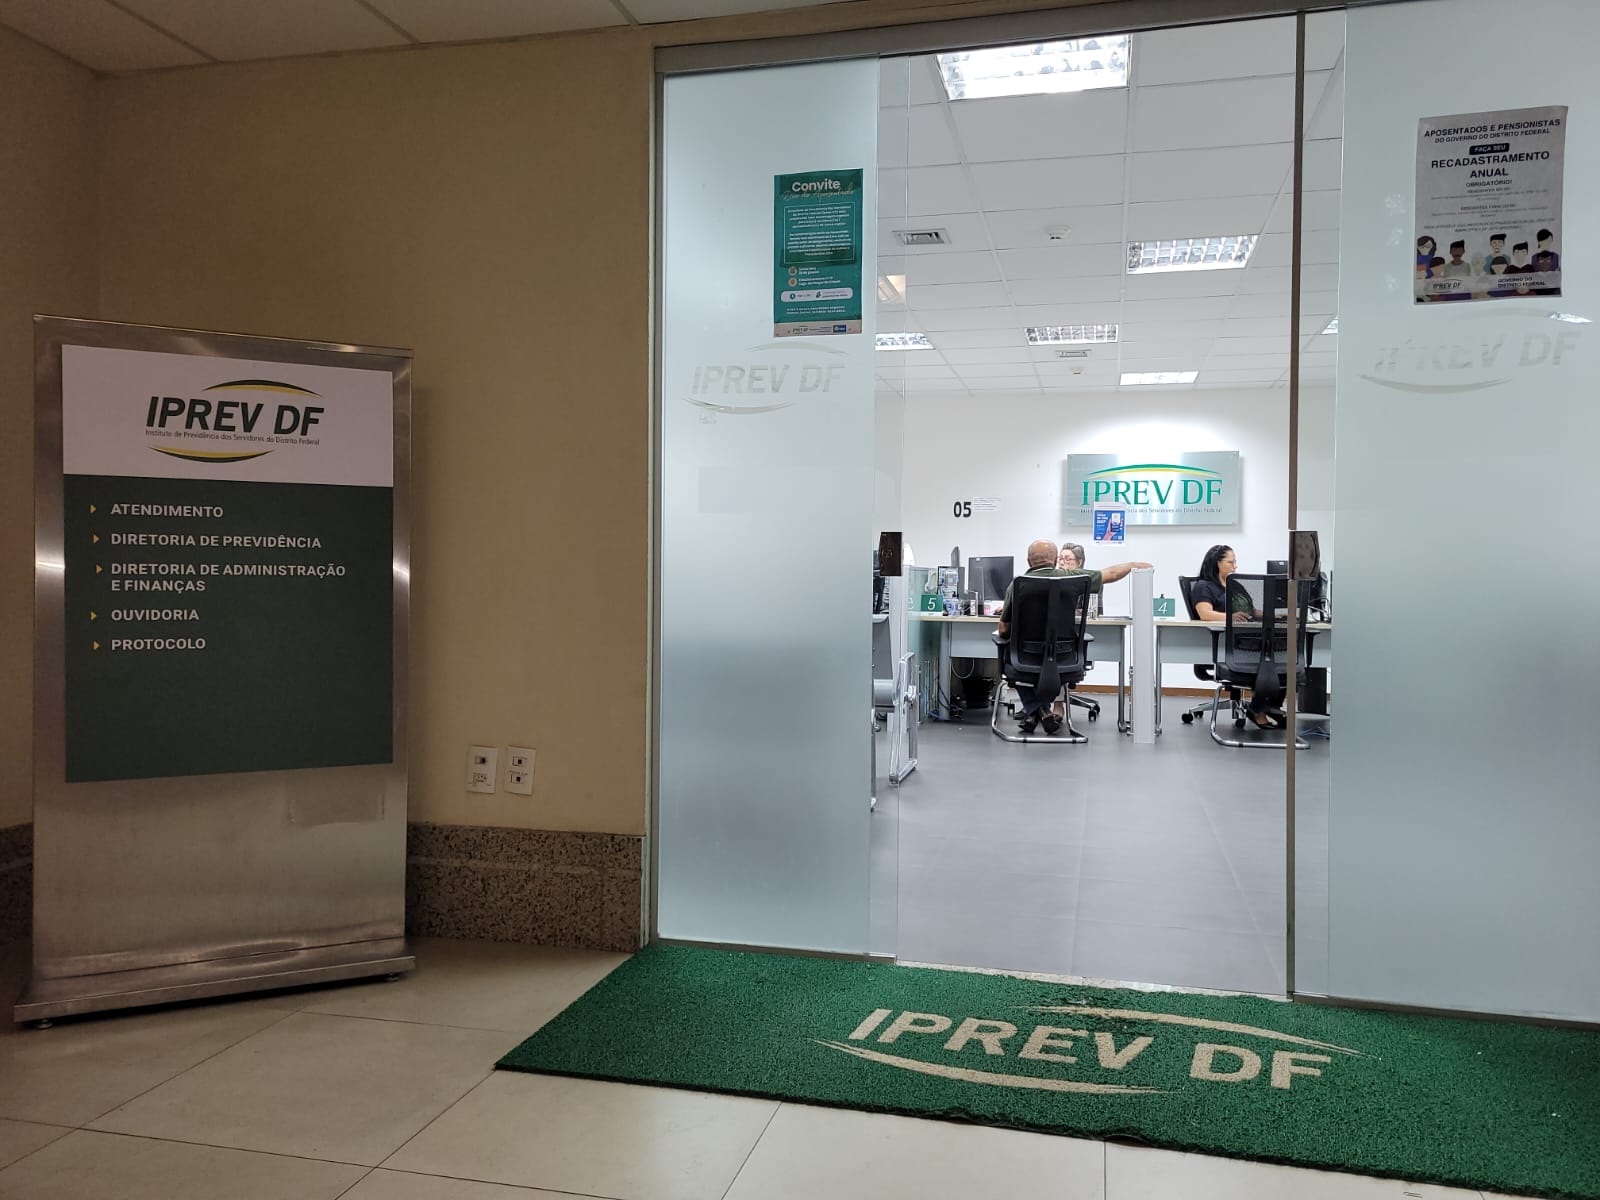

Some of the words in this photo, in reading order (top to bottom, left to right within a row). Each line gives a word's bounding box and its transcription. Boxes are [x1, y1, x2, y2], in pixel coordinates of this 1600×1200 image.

[1424, 125, 1488, 137] APOSENTADOS
[1498, 119, 1561, 130] PENSIONISTAS
[1446, 134, 1478, 142] GOVERNO
[1490, 130, 1519, 138] DISTRITO
[1521, 128, 1550, 136] FEDERAL
[1431, 151, 1550, 168] RECADASTRAMENTO
[1470, 167, 1509, 178] ANUAL
[791, 178, 841, 192] Convite
[691, 363, 790, 394] IPREV
[798, 362, 846, 393] DF
[146, 396, 264, 433] IPREV
[273, 404, 325, 436] DF
[183, 432, 219, 440] Previdência
[233, 434, 265, 442] Servidores
[298, 438, 320, 446] Federal
[1081, 479, 1174, 506] IPREV
[1181, 479, 1223, 505] DF
[110, 503, 224, 518] ATENDIMENTO
[953, 501, 972, 518] 05
[111, 533, 196, 546] DIRETORIA
[200, 535, 220, 547] DE
[222, 535, 322, 549] PREVIDÊNCIA
[111, 563, 196, 576] DIRETORIA
[200, 564, 220, 576] DE
[222, 563, 346, 579] ADMINISTRAÇÃO
[111, 580, 121, 592] E
[124, 579, 206, 594] FINANÇAS
[927, 597, 937, 611] 5
[1157, 601, 1168, 615] 4
[111, 608, 199, 621] OUVIDORIA
[111, 637, 206, 651] PROTOCOLO
[847, 1008, 1153, 1070] IPREV
[1189, 1042, 1332, 1090] DF
